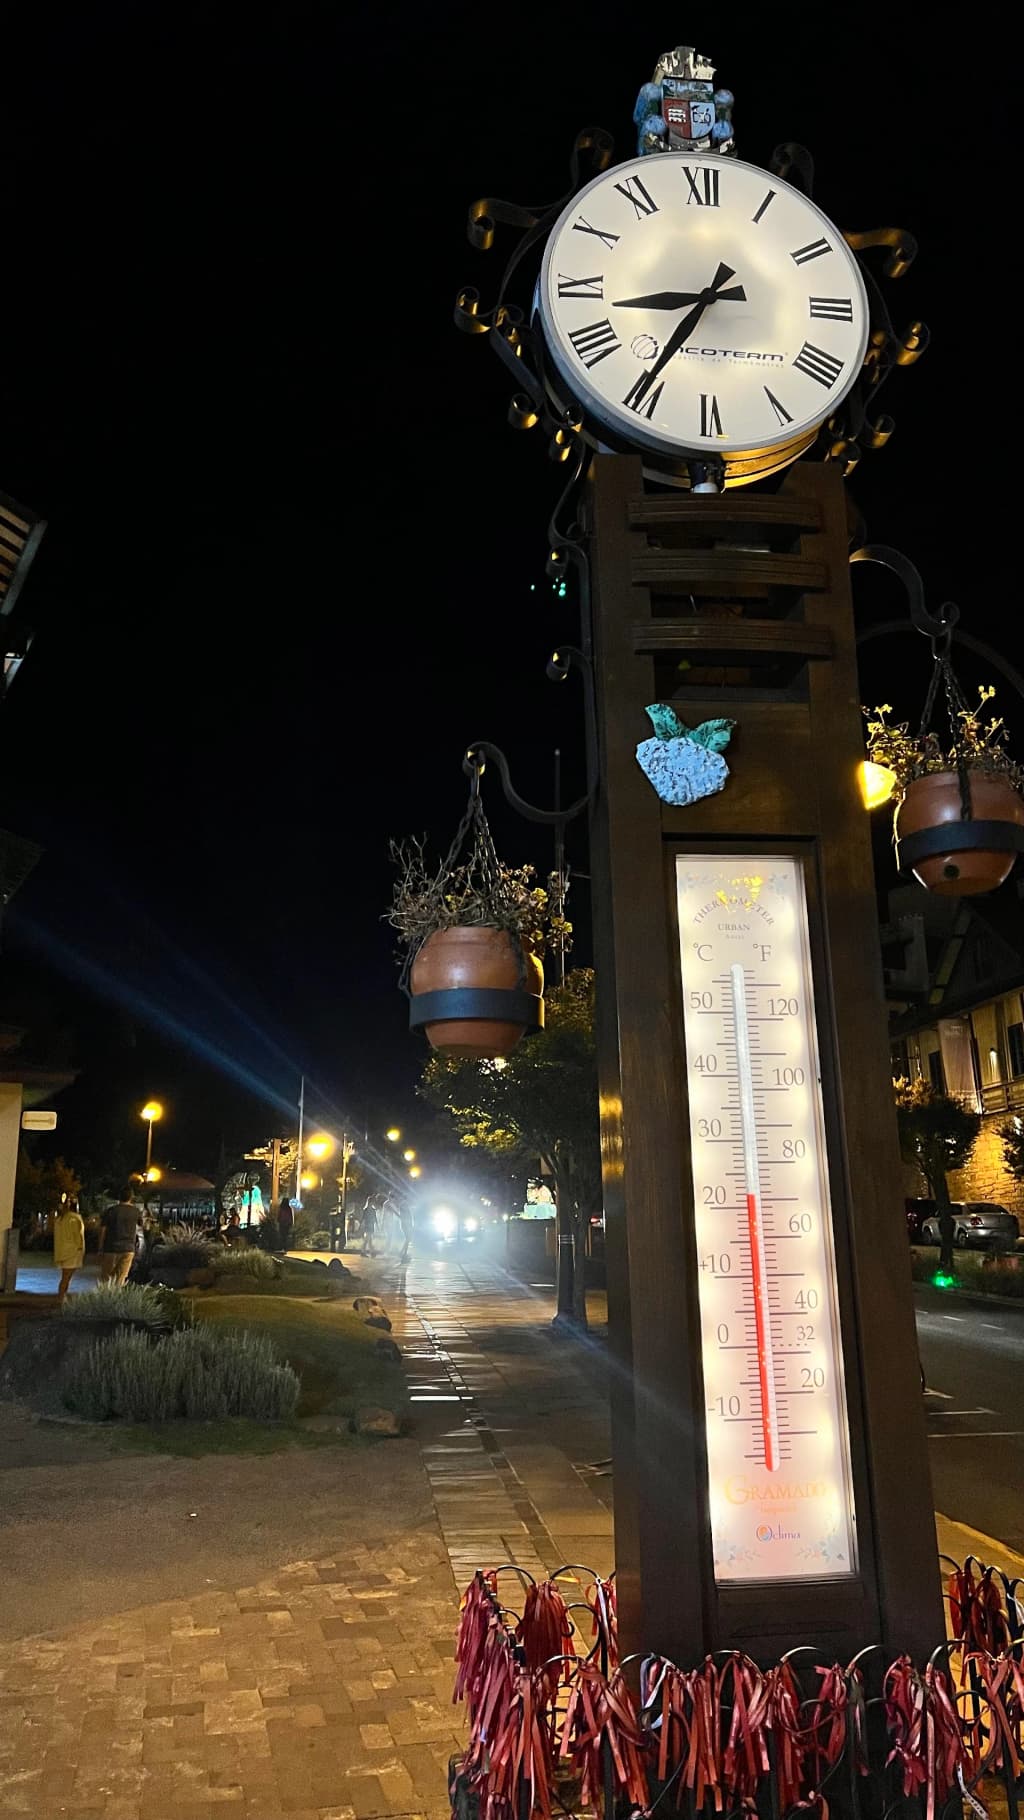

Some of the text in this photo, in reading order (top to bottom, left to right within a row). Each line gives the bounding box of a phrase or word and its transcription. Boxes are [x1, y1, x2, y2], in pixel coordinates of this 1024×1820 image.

[613, 174, 660, 220] XI
[681, 166, 720, 207] XII
[572, 216, 620, 249] X
[789, 237, 833, 266] II
[558, 273, 604, 300] IX
[809, 296, 853, 322] III
[792, 340, 844, 390] IIII
[700, 393, 731, 439] VI
[763, 385, 794, 427] V
[718, 923, 750, 932] URBAN
[690, 991, 713, 1010] 50
[767, 998, 799, 1016] 120
[693, 1054, 718, 1073] 40
[772, 1067, 805, 1087] 100
[698, 1119, 722, 1138] 30
[782, 1139, 806, 1159] 80
[702, 1185, 727, 1206] 20
[788, 1213, 813, 1234] 60
[698, 1253, 731, 1273] +10
[794, 1288, 818, 1310] 40
[717, 1323, 730, 1344] 0
[796, 1326, 815, 1341] 32
[800, 1367, 825, 1388] 20
[707, 1395, 741, 1417] -10
